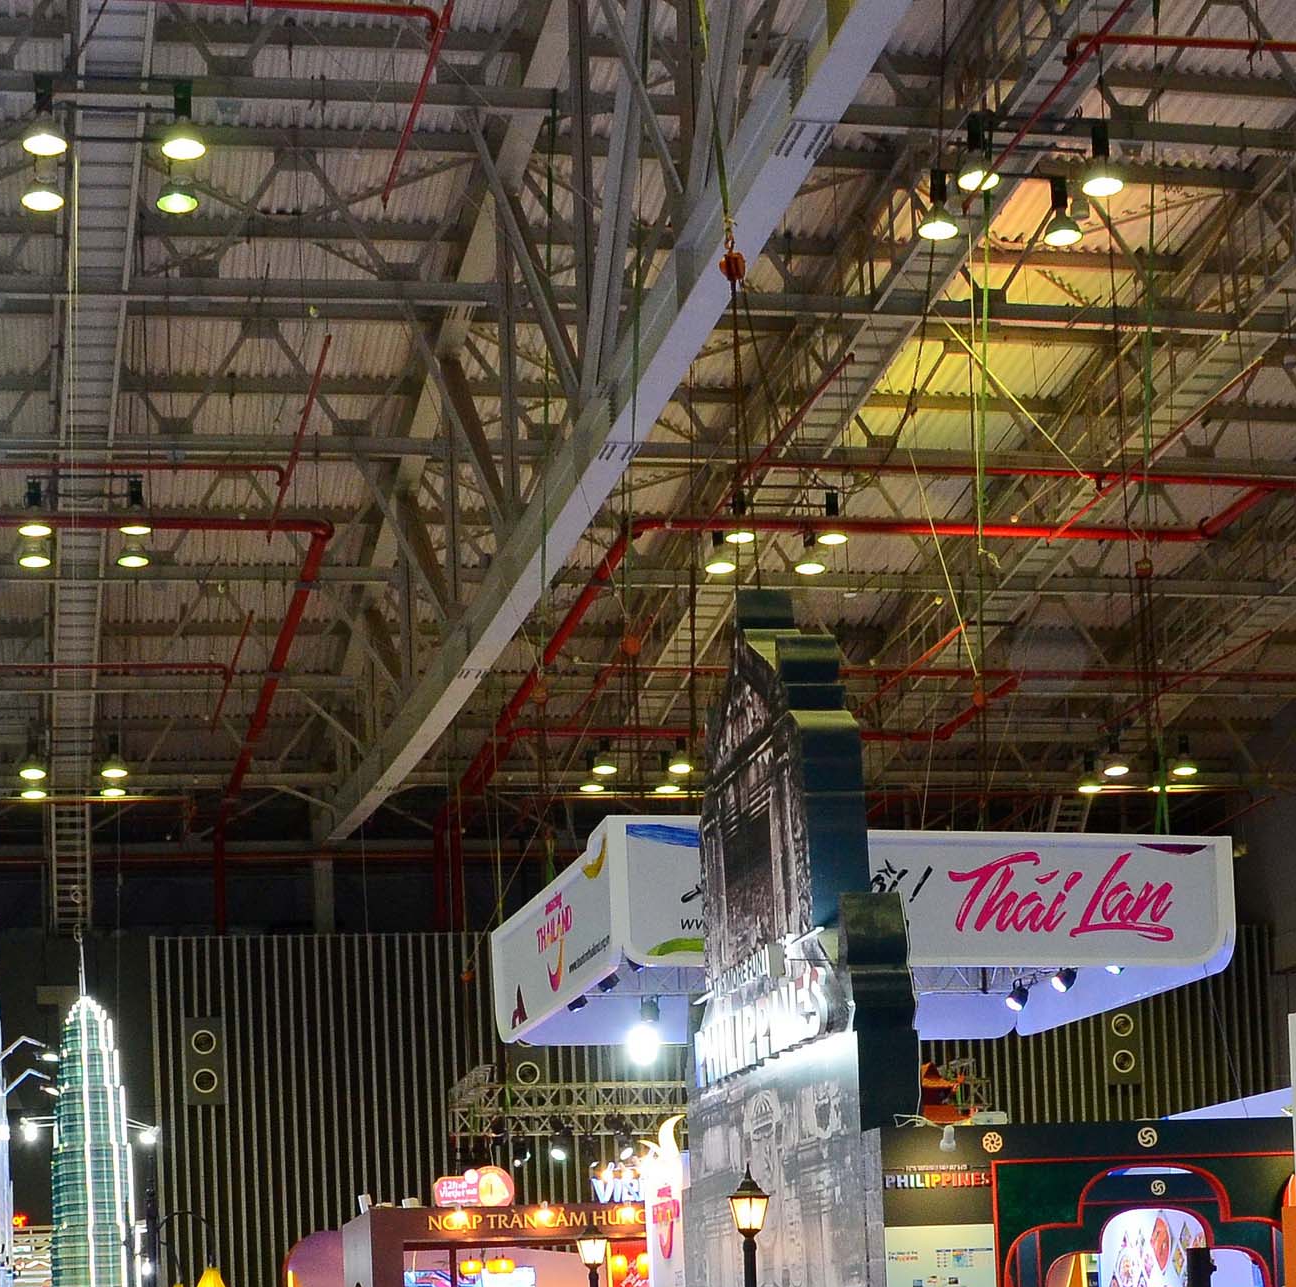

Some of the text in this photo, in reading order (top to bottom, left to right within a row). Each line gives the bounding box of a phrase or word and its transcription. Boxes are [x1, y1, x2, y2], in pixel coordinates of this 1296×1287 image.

[947, 851, 1084, 932] Thái
[1069, 852, 1174, 942] Lan
[884, 1171, 993, 1189] PHILIPPINES
